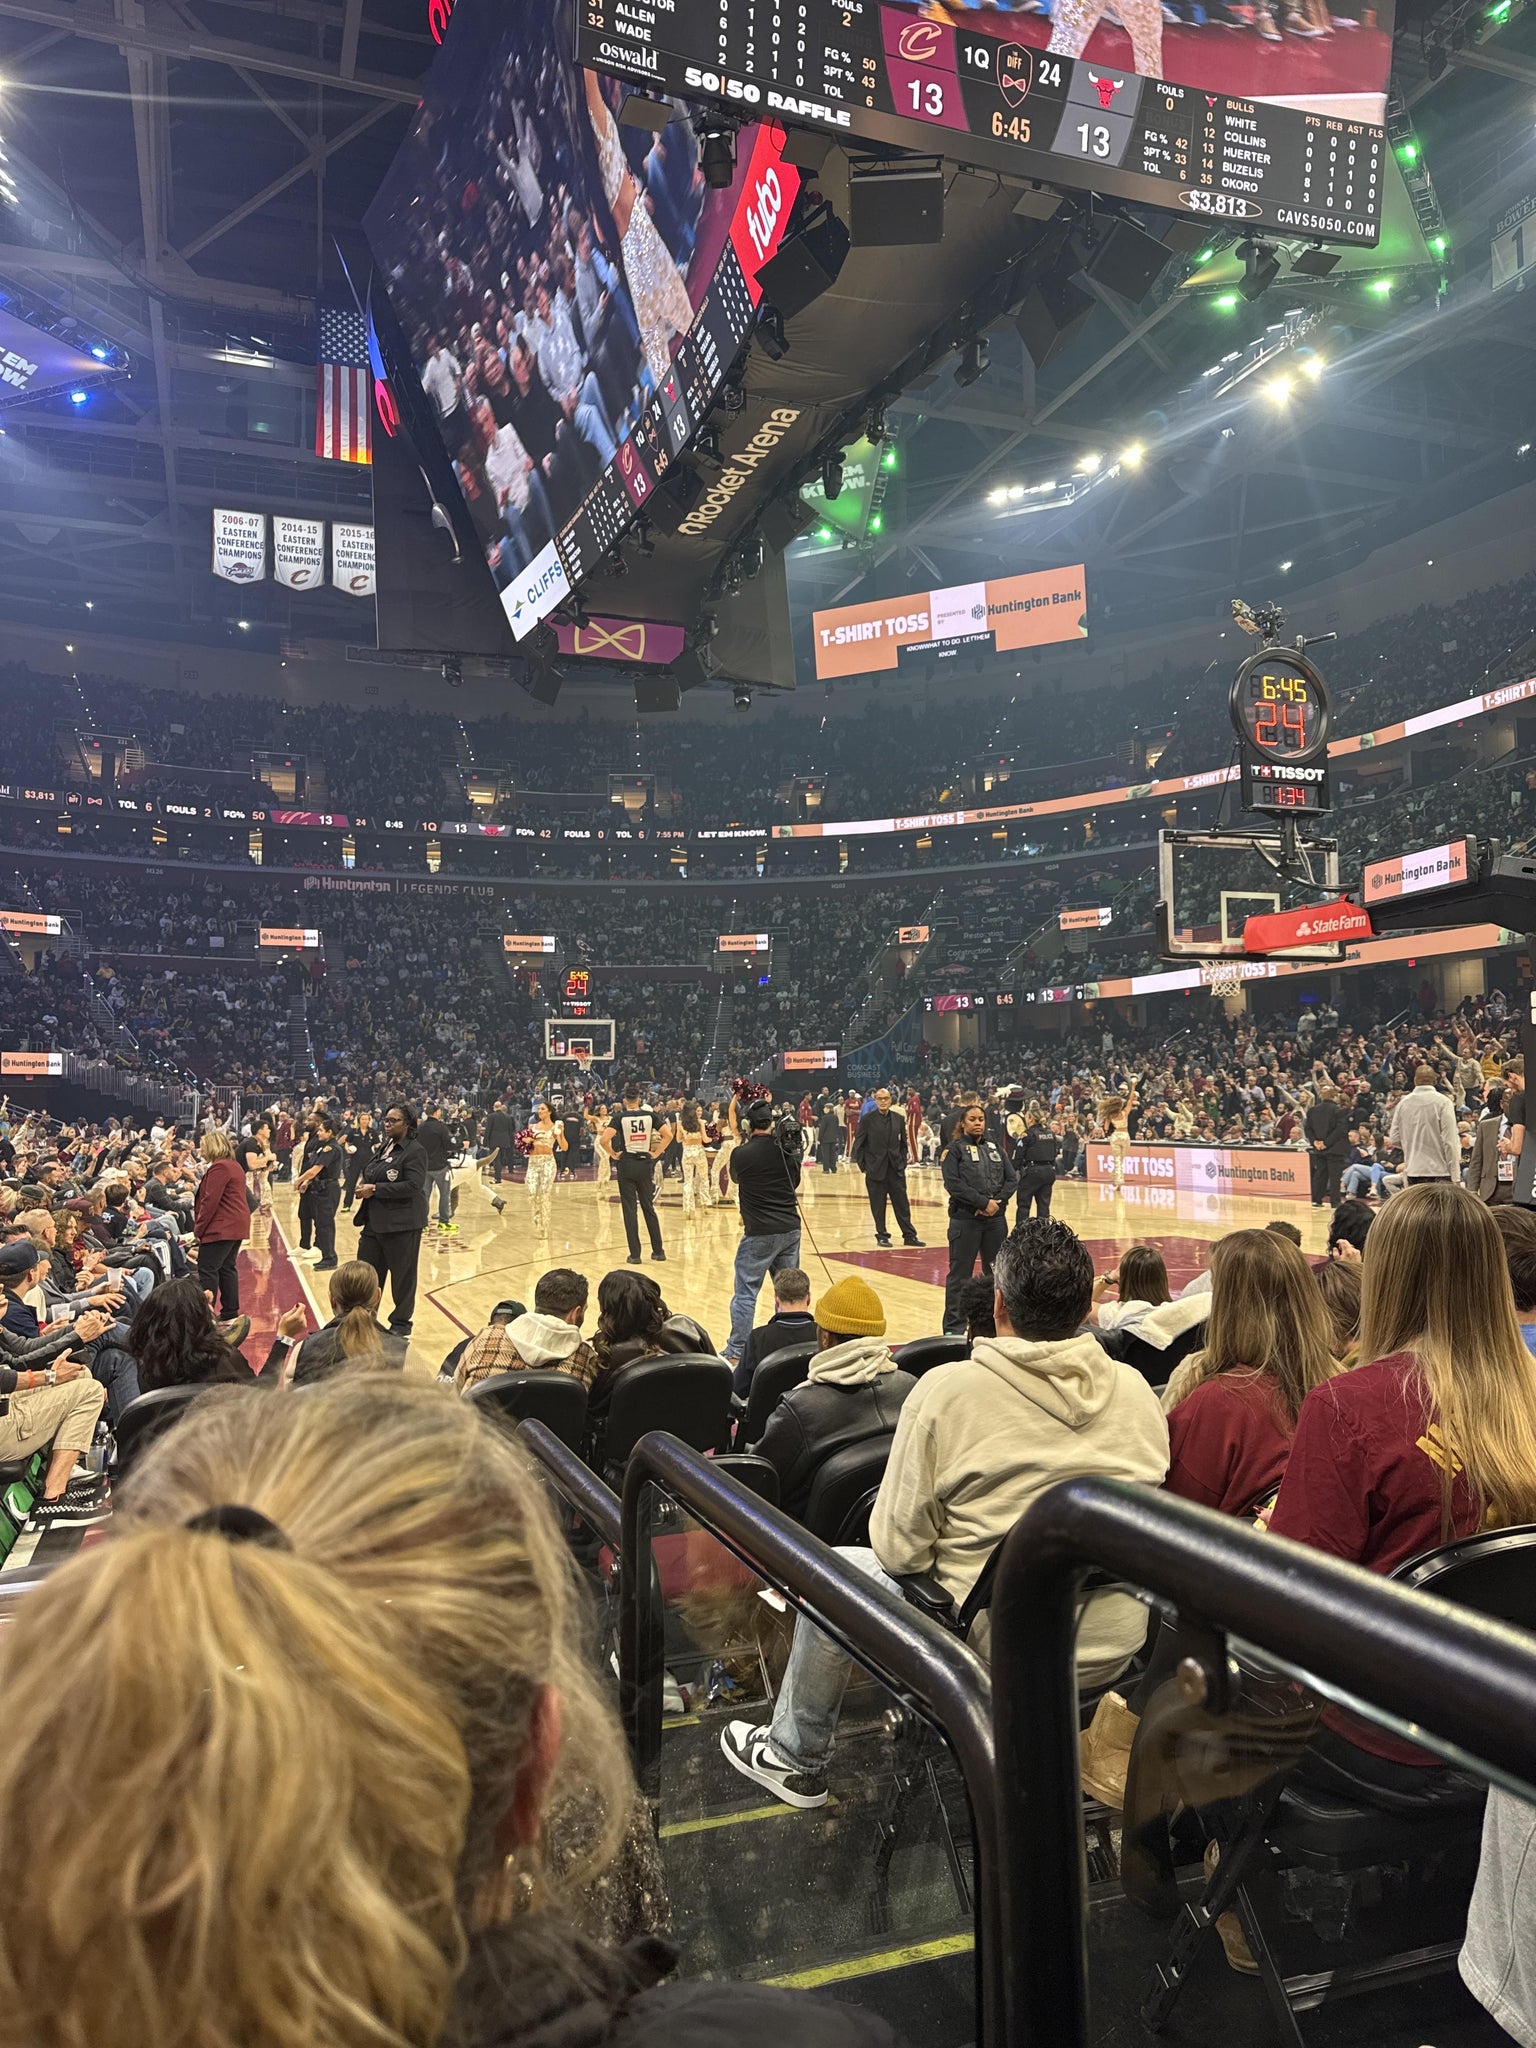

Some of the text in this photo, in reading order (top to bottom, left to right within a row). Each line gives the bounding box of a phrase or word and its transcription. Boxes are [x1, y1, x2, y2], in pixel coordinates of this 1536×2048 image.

[798, 5, 807, 18] 0
[832, 0, 863, 14] FOULS
[842, 11, 852, 27] 2
[748, 7, 806, 35] 1 0 2
[616, 2, 655, 25] ALLEN
[718, 34, 727, 47] 0
[746, 43, 755, 55] 2
[772, 50, 778, 62] 1
[797, 58, 803, 70] 1
[719, 16, 805, 52] 6 1 0 0
[588, 12, 804, 87] 32 WADE 2 2 1 0
[600, 42, 658, 71] oswald
[824, 46, 877, 72] FG 50
[964, 46, 990, 70] 1Q
[1006, 55, 1023, 70] DIFF
[1038, 60, 1061, 88] 24
[823, 64, 876, 89] 3PT 43
[822, 83, 873, 108] TOL 6
[907, 79, 943, 116] 13
[1156, 83, 1184, 98] FOULS
[767, 91, 851, 127] RAFFLE
[1166, 97, 1174, 111] 0
[991, 111, 1031, 143] 6:45
[1226, 100, 1384, 139] BULLS PTS REB AST FLS
[1077, 122, 1110, 157] 13
[1144, 130, 1188, 150] FG 42
[1206, 112, 1378, 154] 0 WHITE 0 0 0 0
[1143, 146, 1187, 165] 3PT 33
[1203, 127, 1377, 169] 12 COLLINS 0 0 0 0
[1142, 160, 1186, 180] TOL 6
[1202, 142, 1376, 184] 13 HUERTER 0 1 0
[1202, 158, 1375, 199] 14 BUZELIS 1 0 0
[1200, 173, 1374, 214] 35 OKORO 3 0 0 0
[746, 167, 781, 261] fubo
[1188, 190, 1376, 237] $3,813 CAVS5050.COM
[1511, 224, 1524, 270] 1
[673, 414, 686, 440] 13
[731, 408, 800, 468] Arena
[633, 473, 647, 497] 13
[685, 467, 753, 524] Rocket
[222, 514, 259, 527] 2006-07
[281, 522, 318, 534] 2014-15
[216, 536, 264, 550] CONFERENCE
[222, 527, 258, 539] EASTERN
[283, 534, 316, 546] EASTERN
[218, 547, 262, 560] CHAMPIONS
[276, 544, 323, 557] CONFERENCE
[342, 540, 374, 551] EASTERN
[278, 553, 321, 566] CHAMPIONS
[527, 560, 562, 604] CLIFFS
[820, 590, 1082, 647] T-SHIRT TOSS Huntington Bank
[1262, 676, 1307, 703] 6:45
[1484, 684, 1527, 708] T-SHIRT
[1254, 701, 1305, 748] 24
[1183, 773, 1220, 789] T-SHIRT
[1272, 767, 1325, 781] TISSOT
[1277, 787, 1305, 805] 1:34
[24, 790, 55, 801] $3,813
[118, 800, 138, 810] TOL
[145, 802, 153, 812] 6
[166, 805, 197, 816] FOULS
[204, 808, 211, 818] 2
[224, 810, 246, 819] FG%
[252, 812, 266, 821] 50
[319, 815, 333, 825] 13
[355, 818, 366, 826] 24
[385, 821, 404, 829] 6:45
[422, 822, 437, 832] 1Q
[454, 824, 467, 834] 13
[540, 830, 551, 838] 42
[564, 830, 591, 838] FOULS
[598, 831, 604, 839] 0
[638, 831, 644, 839] 6
[896, 817, 931, 830] T-SHIRT
[932, 814, 954, 824] TOSS
[985, 810, 1018, 818] Huntington
[1384, 856, 1461, 885] Huntington Bank
[321, 876, 390, 892] Huntington
[10, 918, 43, 927] Huntington
[570, 971, 589, 981] 6:45
[1240, 964, 1266, 978] TOSS
[566, 980, 587, 996] 24
[956, 997, 969, 1008] 13
[974, 997, 984, 1005] 1Q
[996, 994, 1013, 1005] 6:45
[1026, 992, 1035, 1002] 24
[1041, 990, 1054, 1002] 13
[1077, 992, 1083, 1000] 0
[12, 1060, 45, 1068] Huntington
[631, 1120, 645, 1133] 54
[1141, 1157, 1295, 1182] TOSS Huntington Bank
